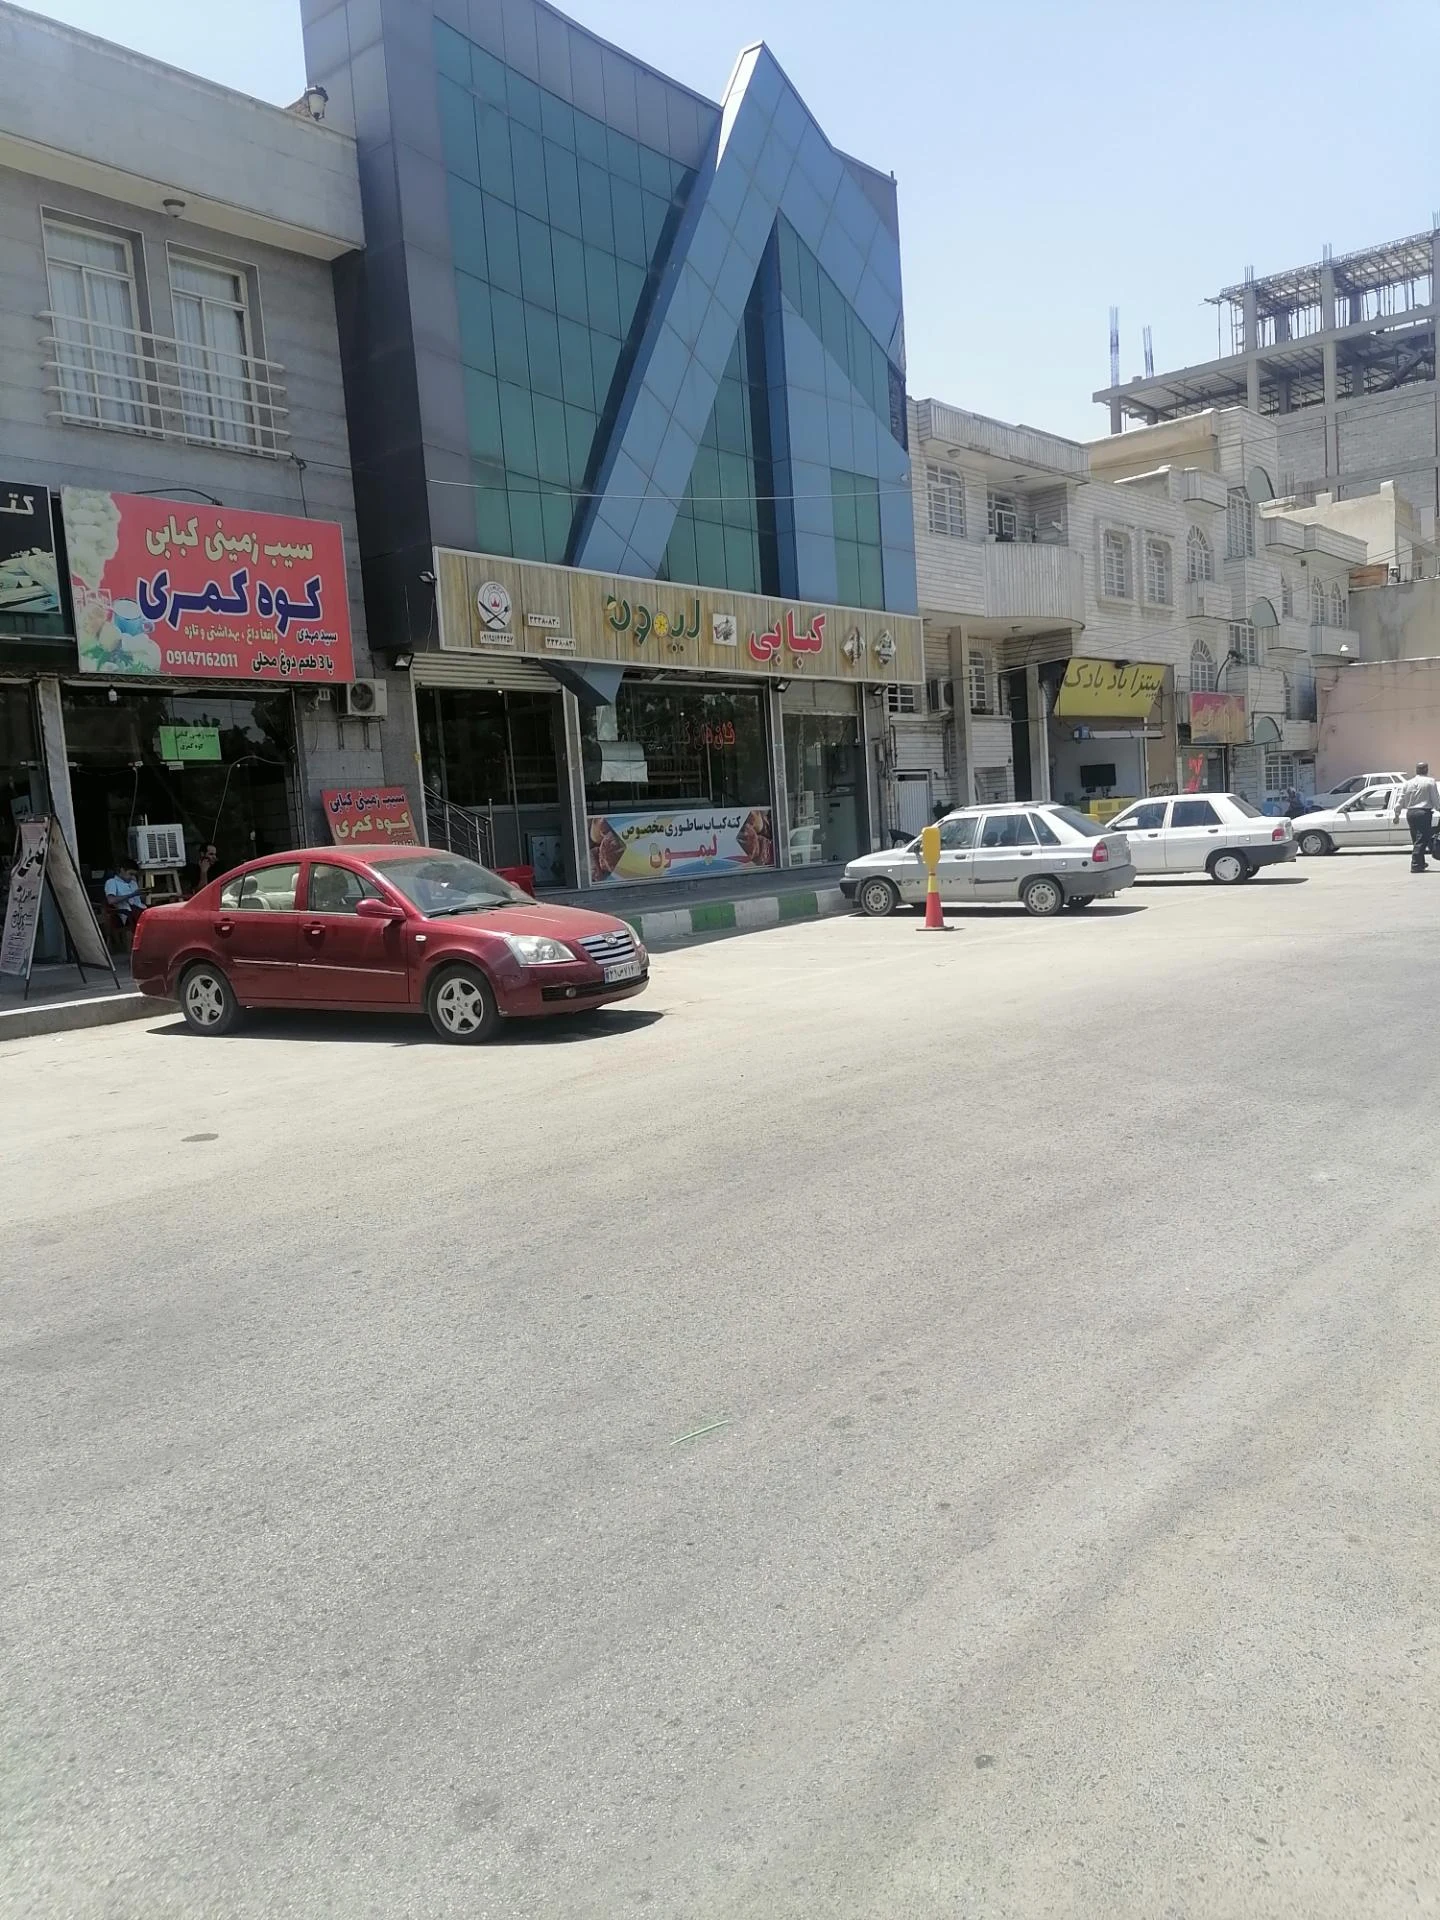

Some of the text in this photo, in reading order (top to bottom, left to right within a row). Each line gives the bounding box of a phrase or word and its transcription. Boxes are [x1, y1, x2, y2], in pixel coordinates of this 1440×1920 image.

[145, 515, 314, 568] سیب زمینی کبابی
[136, 567, 323, 636] کوه کمری
[184, 623, 199, 640] تازه
[206, 624, 241, 642] بهداشتی
[296, 628, 338, 646] سید مهدی
[748, 607, 827, 670] کبابی
[166, 649, 239, 669] 09147162011
[252, 651, 278, 674] محلی
[279, 649, 298, 675] دوغ
[298, 653, 317, 675] طعم
[1130, 667, 1161, 700] پیتزا
[329, 791, 406, 814] سیب زمینی کبابی
[336, 811, 410, 839] کوه کمری
[621, 815, 742, 841] کته کباب ساطوری مخصوص
[649, 833, 718, 869] لیمون
